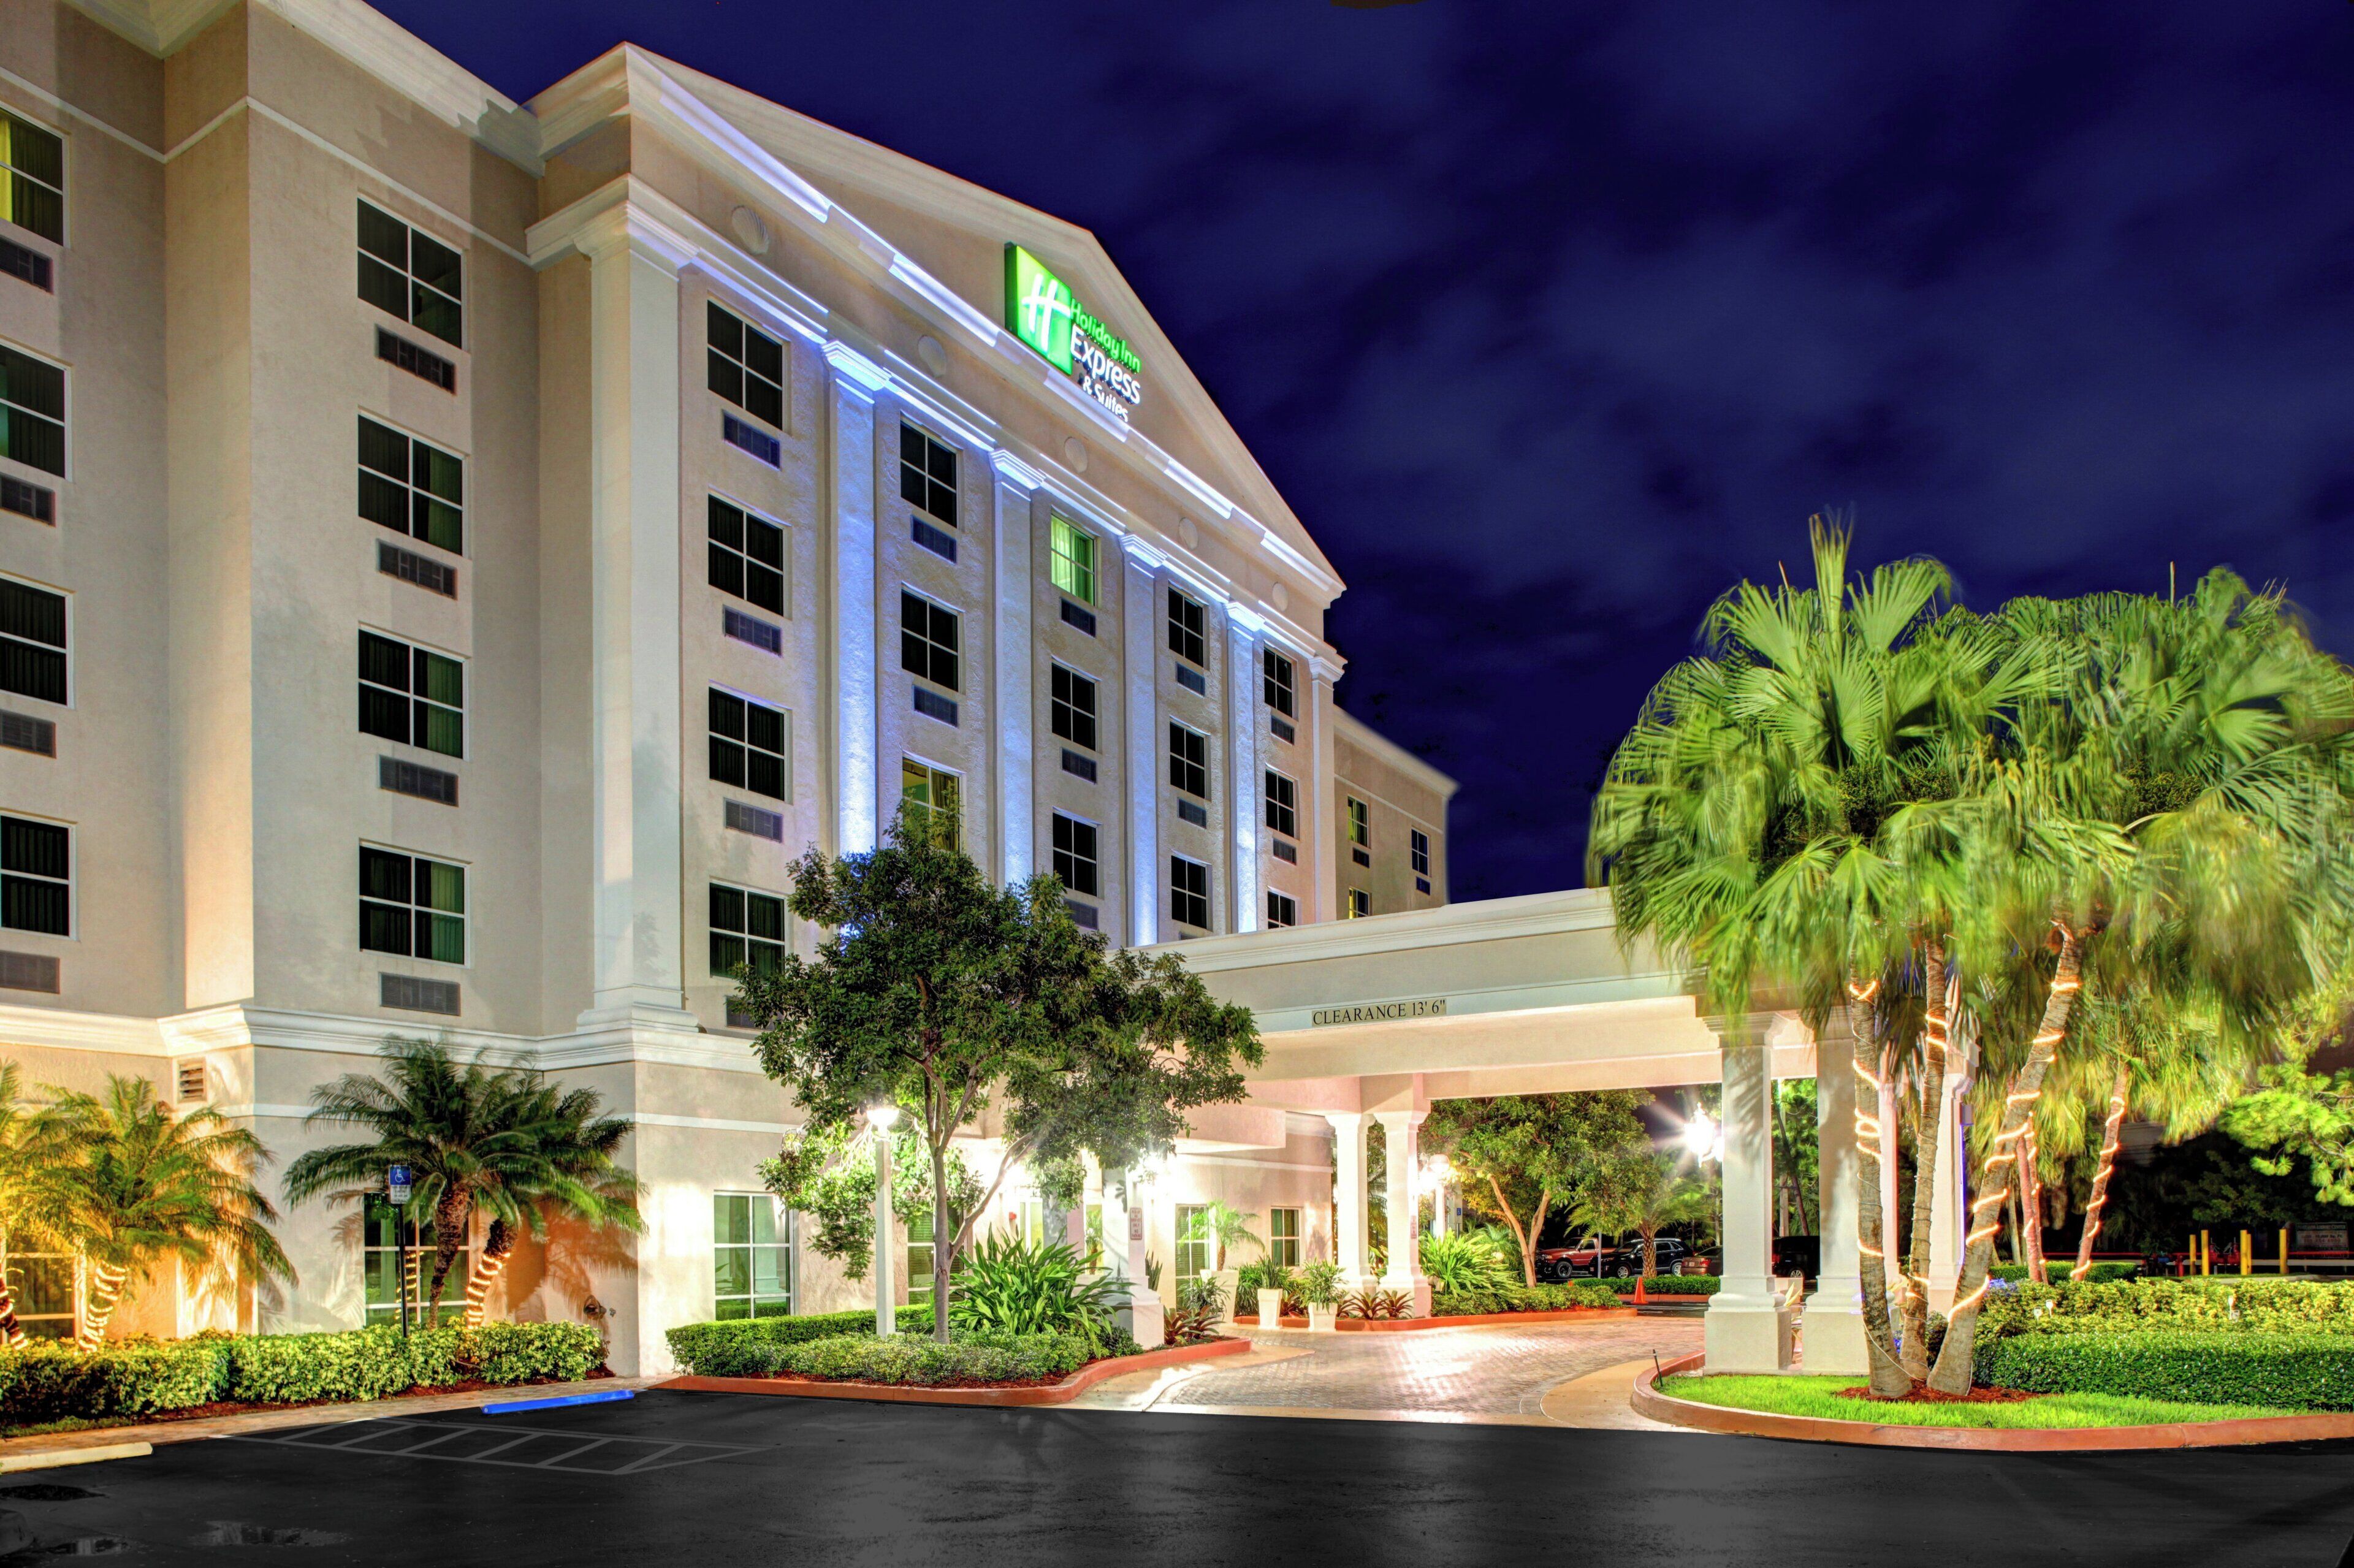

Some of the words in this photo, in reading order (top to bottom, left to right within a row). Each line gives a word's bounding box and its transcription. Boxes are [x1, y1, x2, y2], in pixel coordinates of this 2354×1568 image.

[1070, 299, 1119, 359] Holiday
[1121, 340, 1141, 373] Inn
[1070, 324, 1141, 404] Express
[1083, 375, 1092, 395] &
[1094, 384, 1129, 422] Suites
[1312, 1003, 1407, 1025] CLEARANCE
[1412, 1001, 1427, 1016] 13'
[1431, 999, 1446, 1014] 6"
